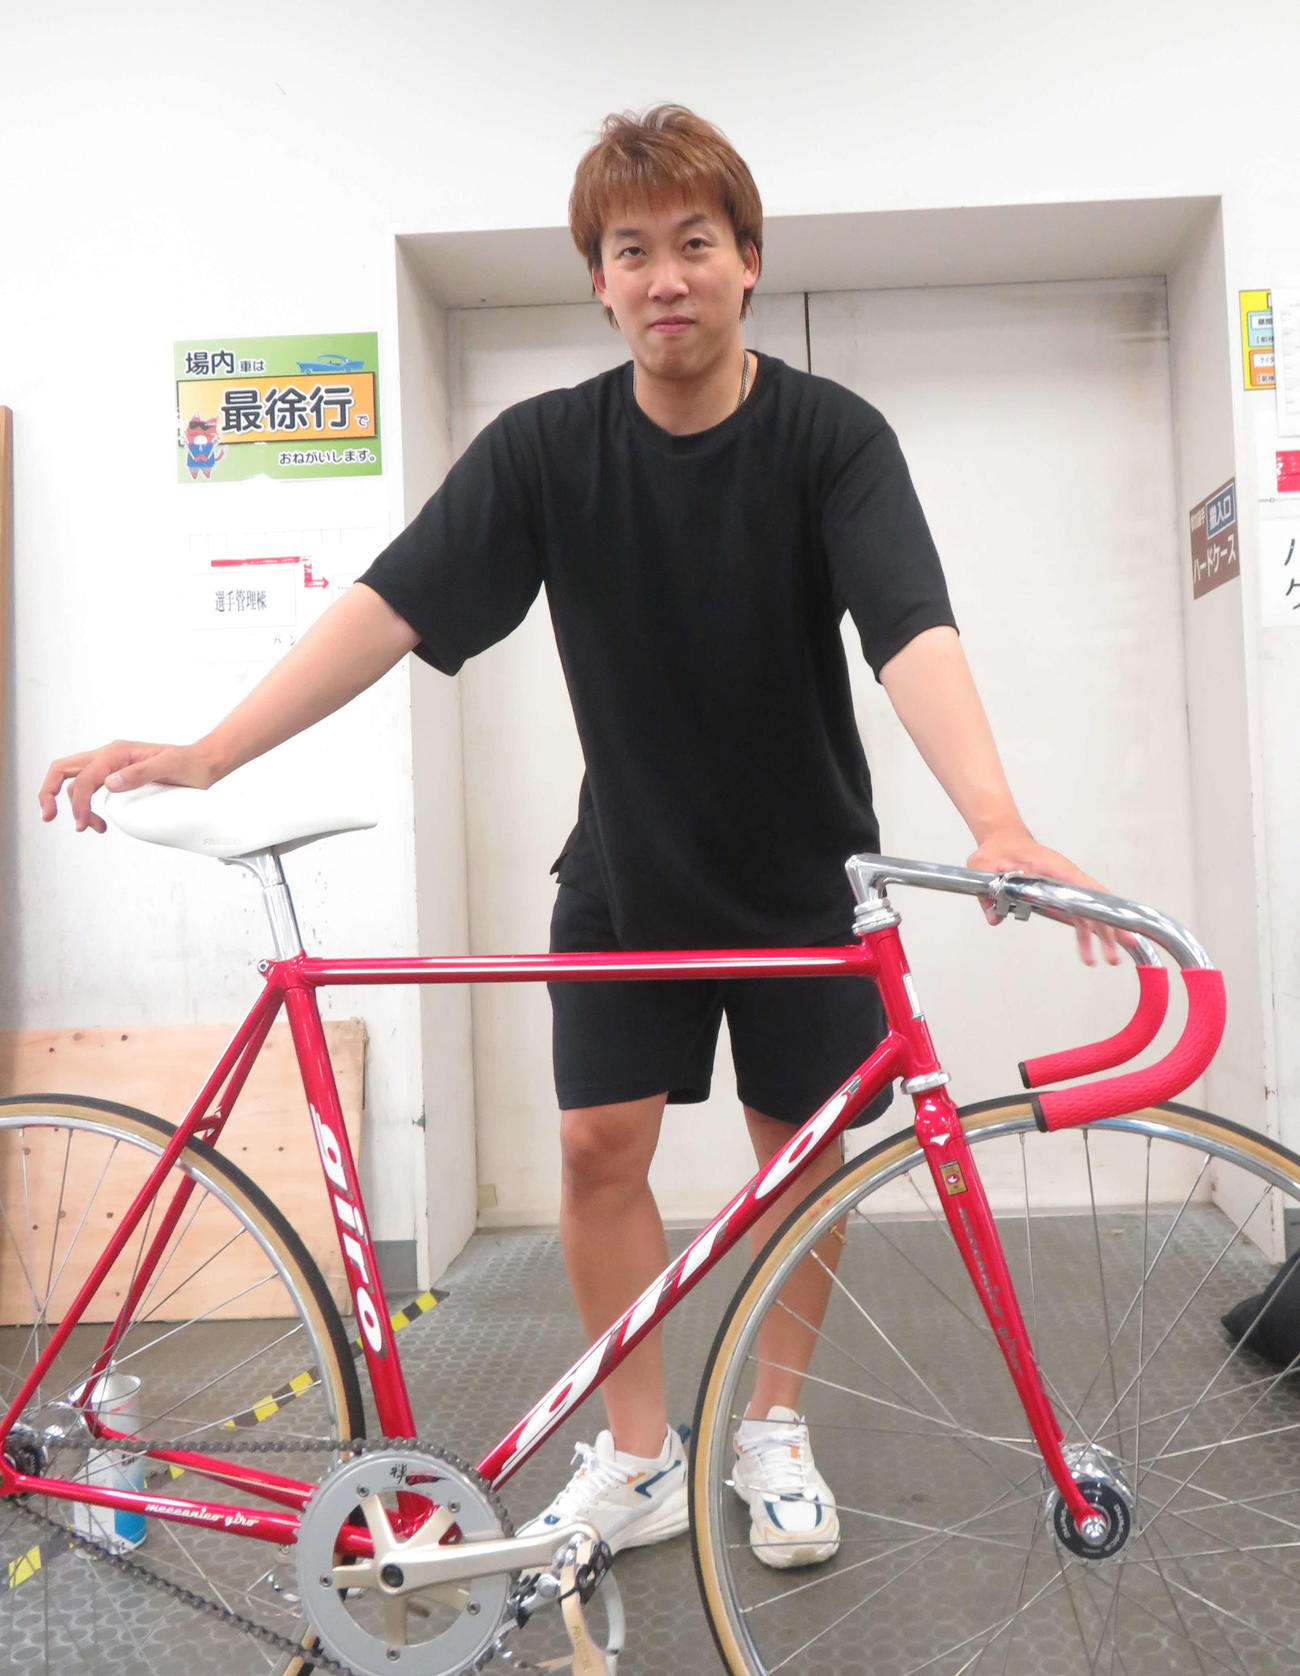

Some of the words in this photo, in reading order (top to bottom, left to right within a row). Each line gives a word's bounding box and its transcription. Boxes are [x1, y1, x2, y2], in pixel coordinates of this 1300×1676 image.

[185, 350, 234, 375] 場内
[240, 360, 265, 372] 車は
[221, 386, 352, 432] 最徐行
[356, 415, 370, 427] で
[279, 450, 376, 465] おねがいします。
[1193, 534, 1237, 585] ハードケース
[215, 589, 267, 612] 選手管理棟
[309, 1102, 383, 1353] giro
[144, 1503, 224, 1521] meccanico
[224, 1511, 260, 1528] giro
